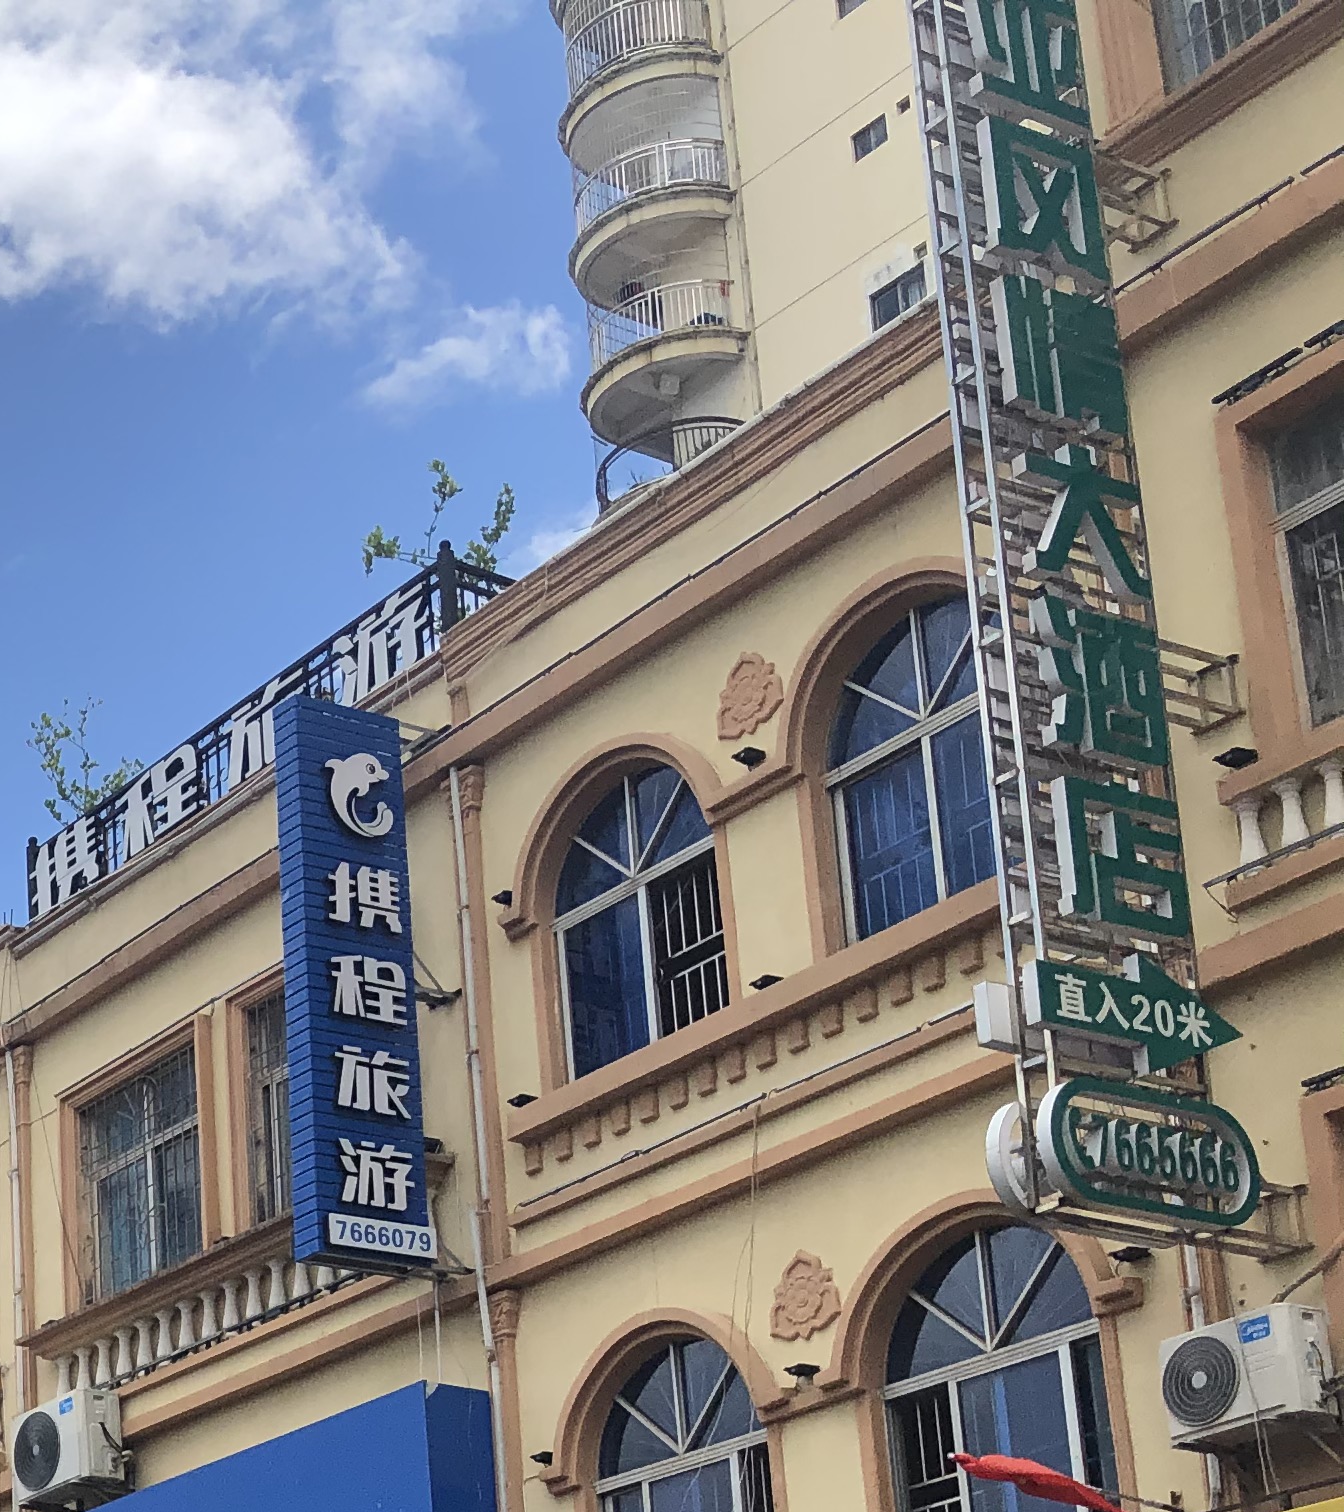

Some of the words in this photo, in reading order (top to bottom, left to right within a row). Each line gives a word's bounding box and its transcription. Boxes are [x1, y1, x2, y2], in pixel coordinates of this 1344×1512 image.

[328, 861, 416, 1213] 携程旅游
[1054, 974, 1214, 1048] 直入20米
[334, 1217, 434, 1257] 7666079
